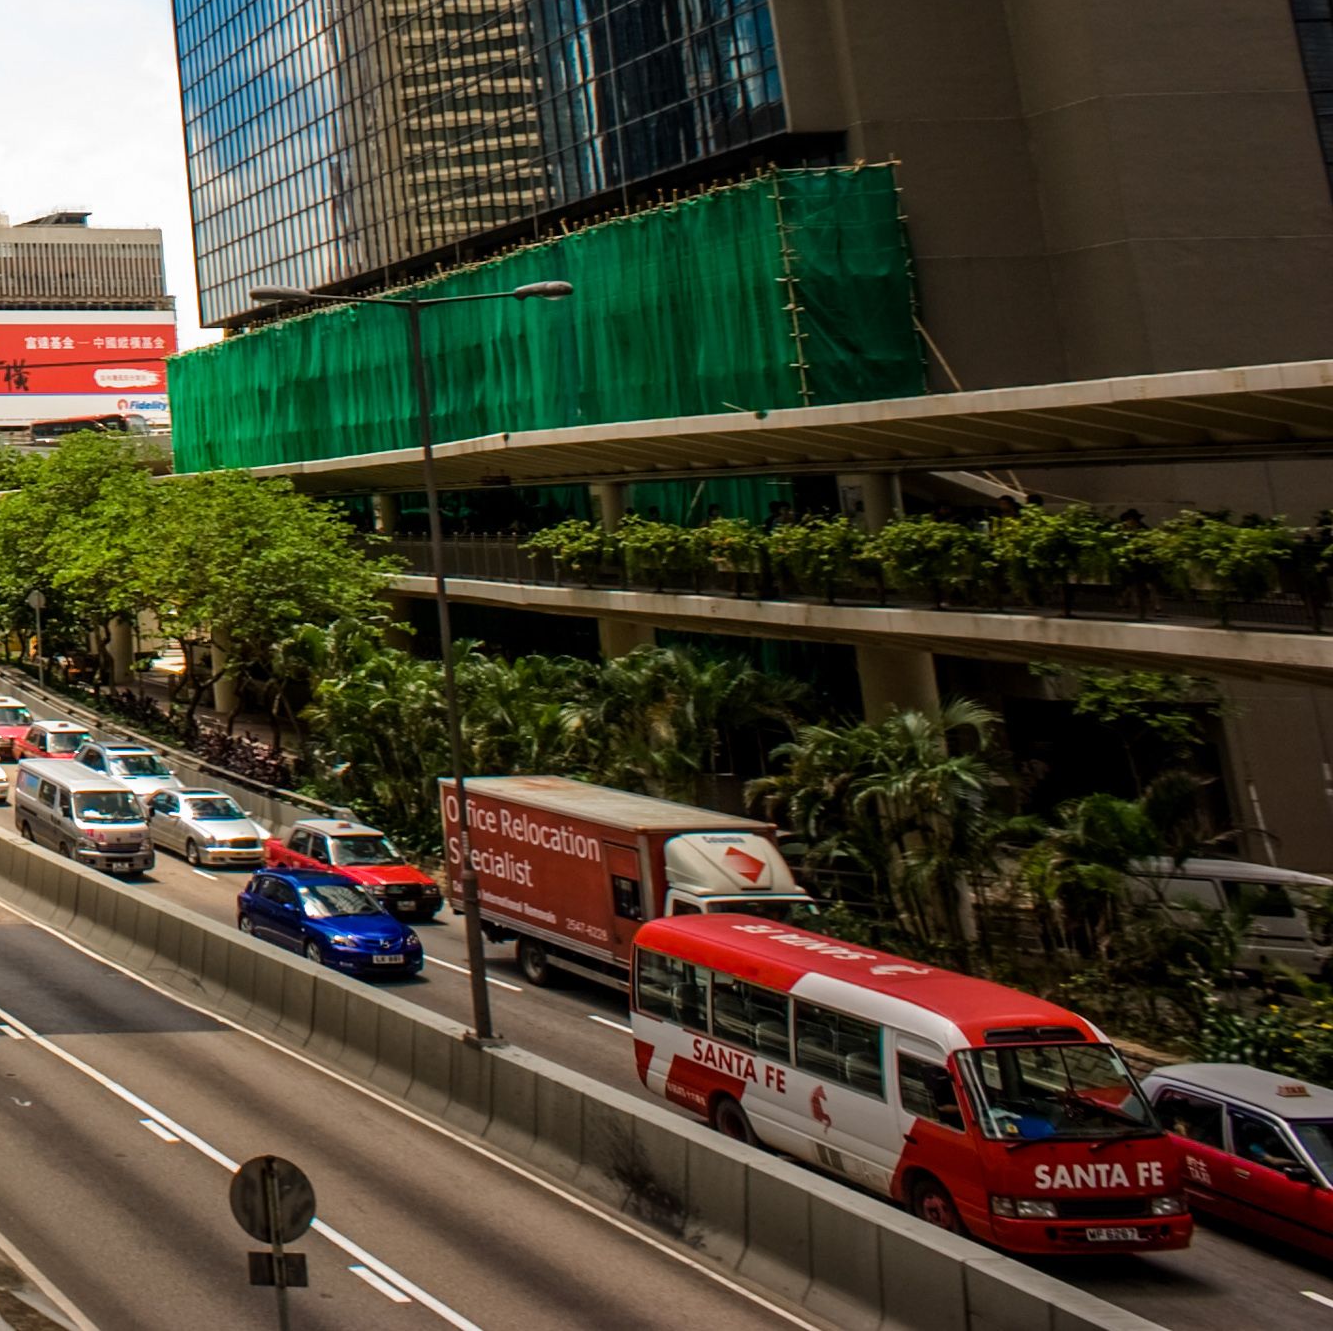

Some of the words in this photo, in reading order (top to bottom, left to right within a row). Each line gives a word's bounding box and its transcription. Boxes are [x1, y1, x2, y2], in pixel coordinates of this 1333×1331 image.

[129, 400, 167, 411] Fidelity
[444, 794, 498, 834] Ofice
[500, 809, 601, 863] Relocation
[448, 838, 534, 887] Secialist
[692, 1038, 759, 1084] SANTA
[765, 1064, 787, 1094] FE
[1034, 1163, 1130, 1190] SANTA
[1138, 1161, 1164, 1187] FE
